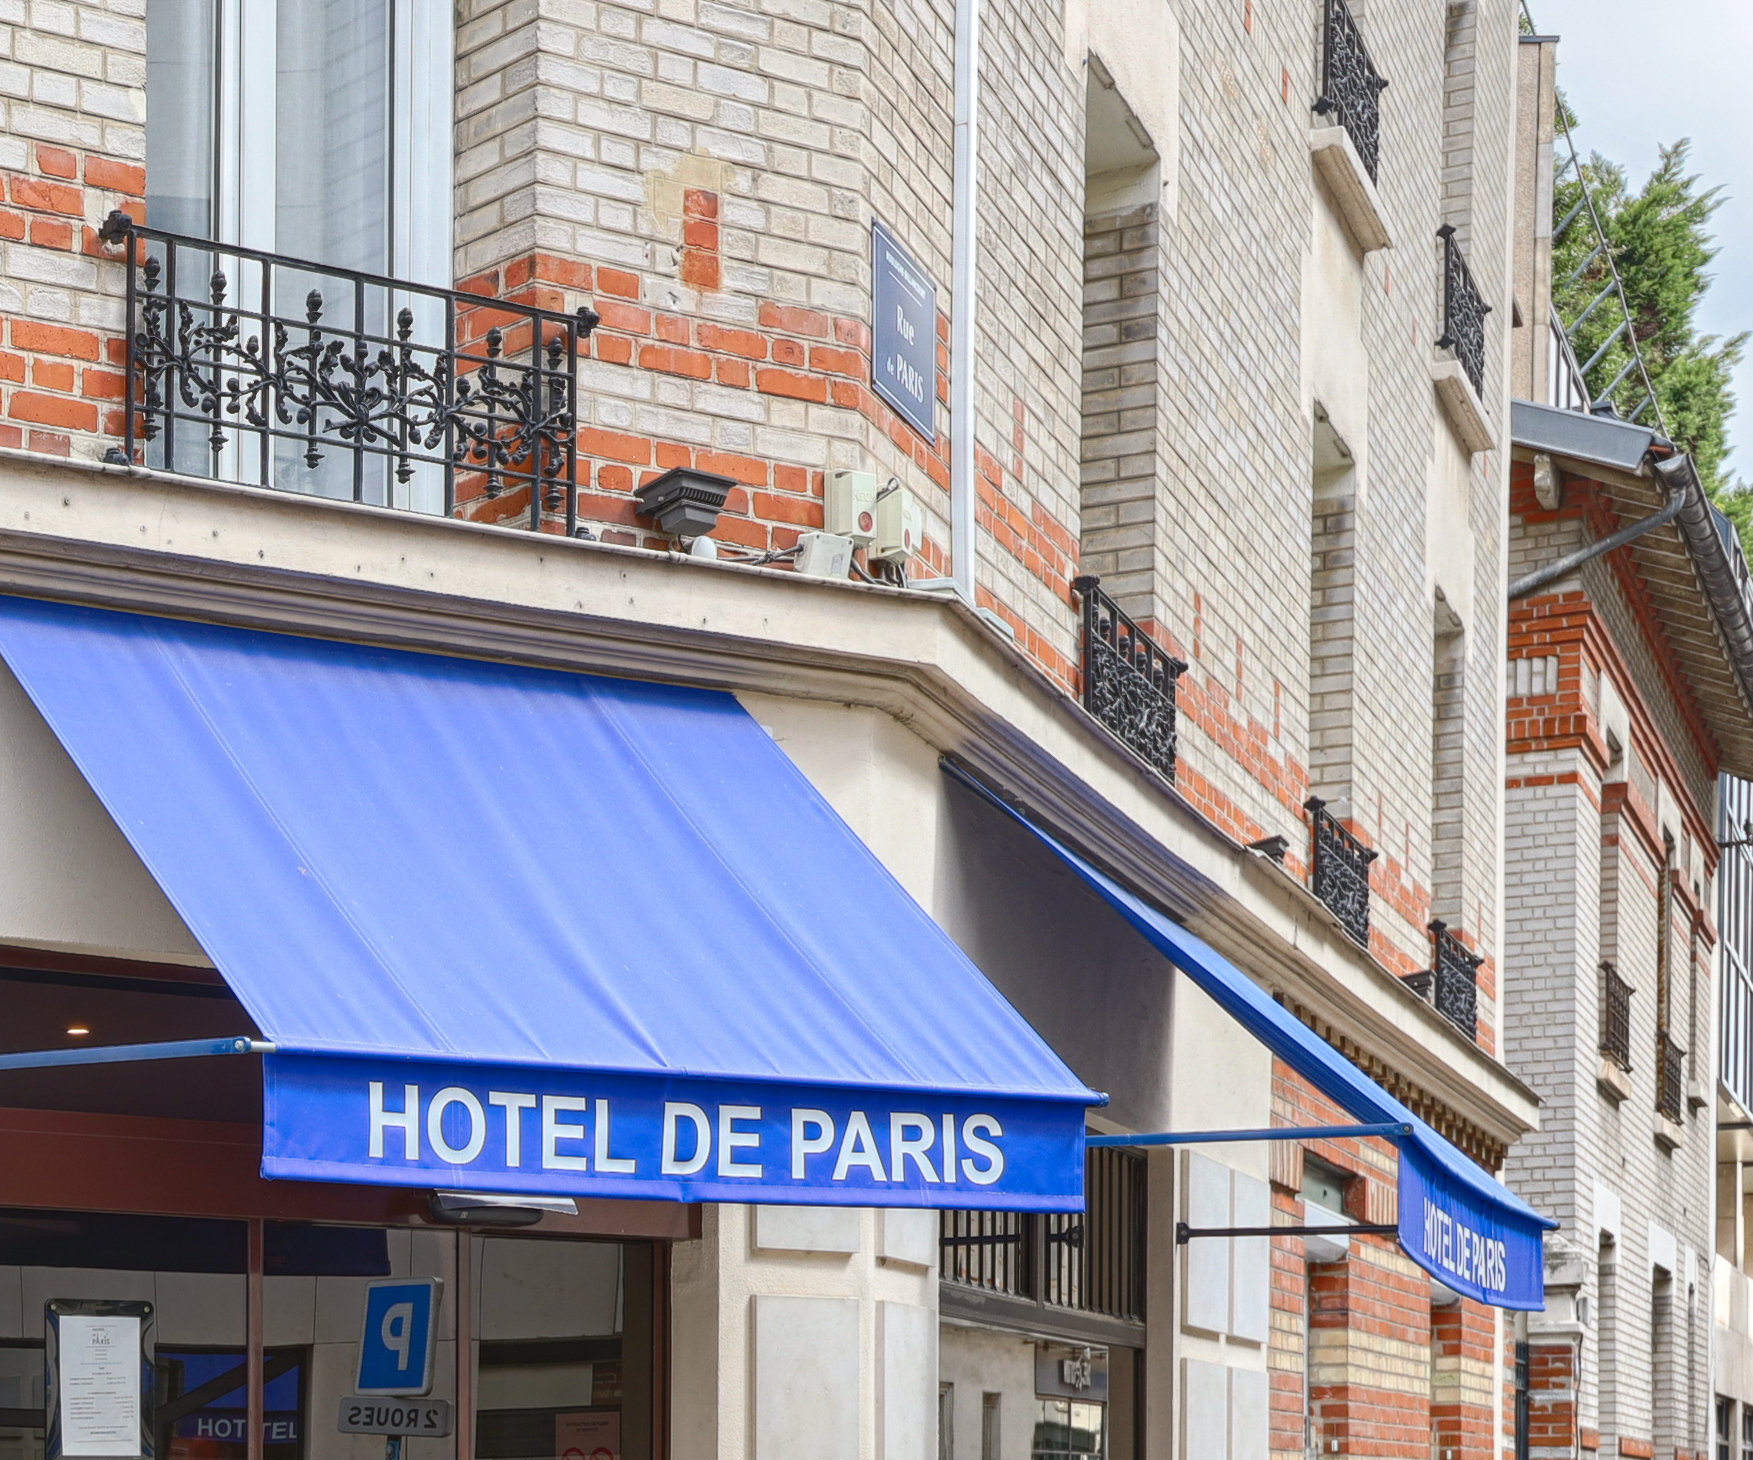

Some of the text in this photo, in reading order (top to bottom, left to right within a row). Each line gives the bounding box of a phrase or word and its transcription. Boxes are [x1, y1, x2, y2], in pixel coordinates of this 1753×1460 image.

[896, 304, 915, 346] Rue
[886, 353, 925, 403] de PARIS
[368, 1080, 1006, 1185] HOTEL DE PARIS
[1424, 1197, 1506, 1292] HOTEL DE PARIS
